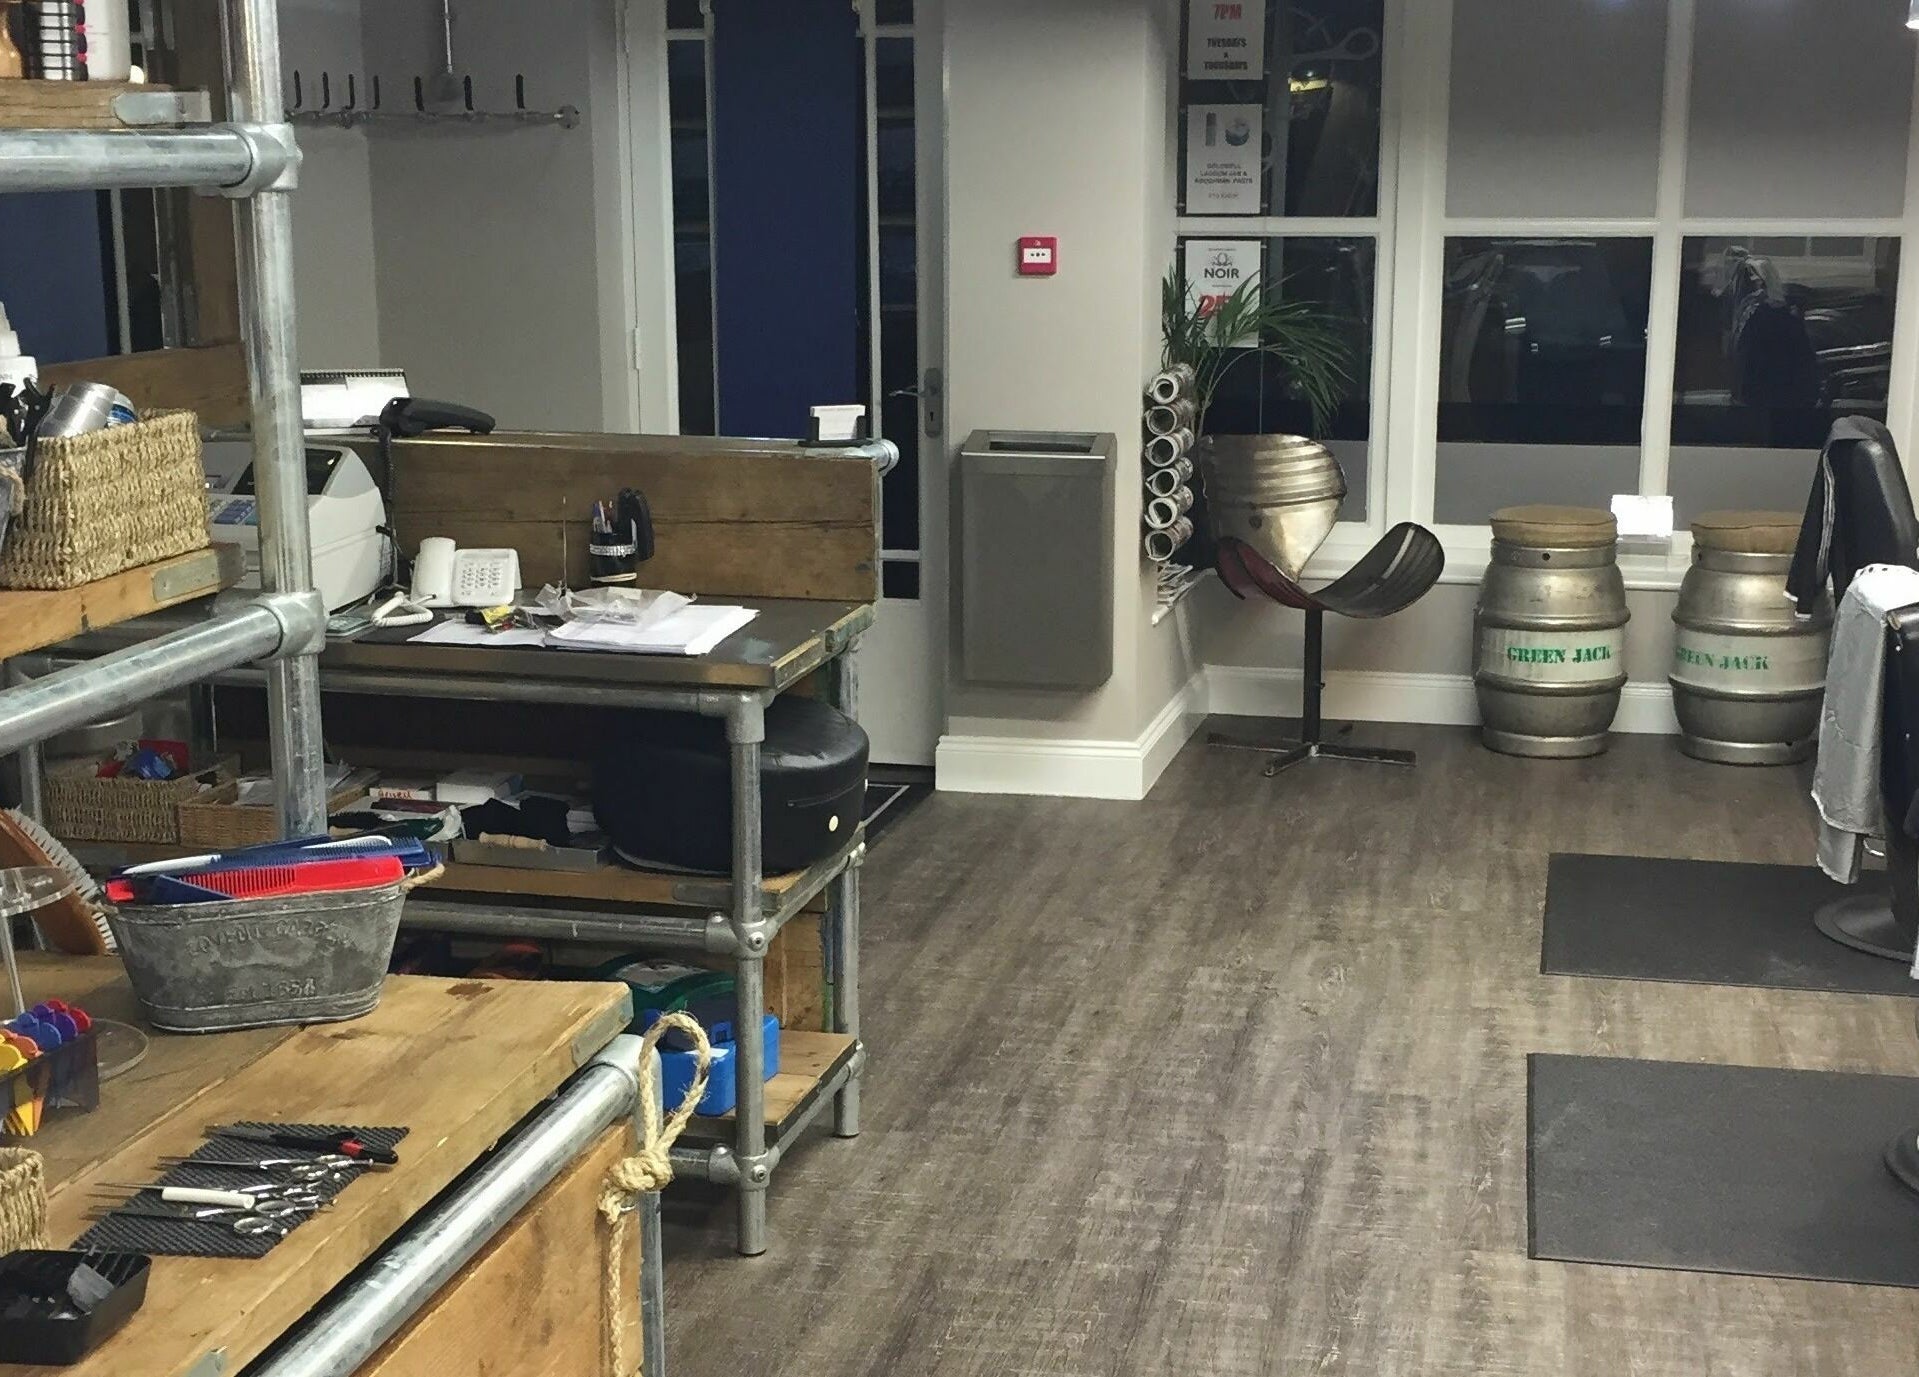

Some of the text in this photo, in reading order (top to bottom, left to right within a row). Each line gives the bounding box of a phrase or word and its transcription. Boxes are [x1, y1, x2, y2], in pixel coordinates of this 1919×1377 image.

[1203, 267, 1240, 279] NOIR
[1507, 645, 1612, 664] GREEN JACK
[1719, 655, 1769, 671] JACK
